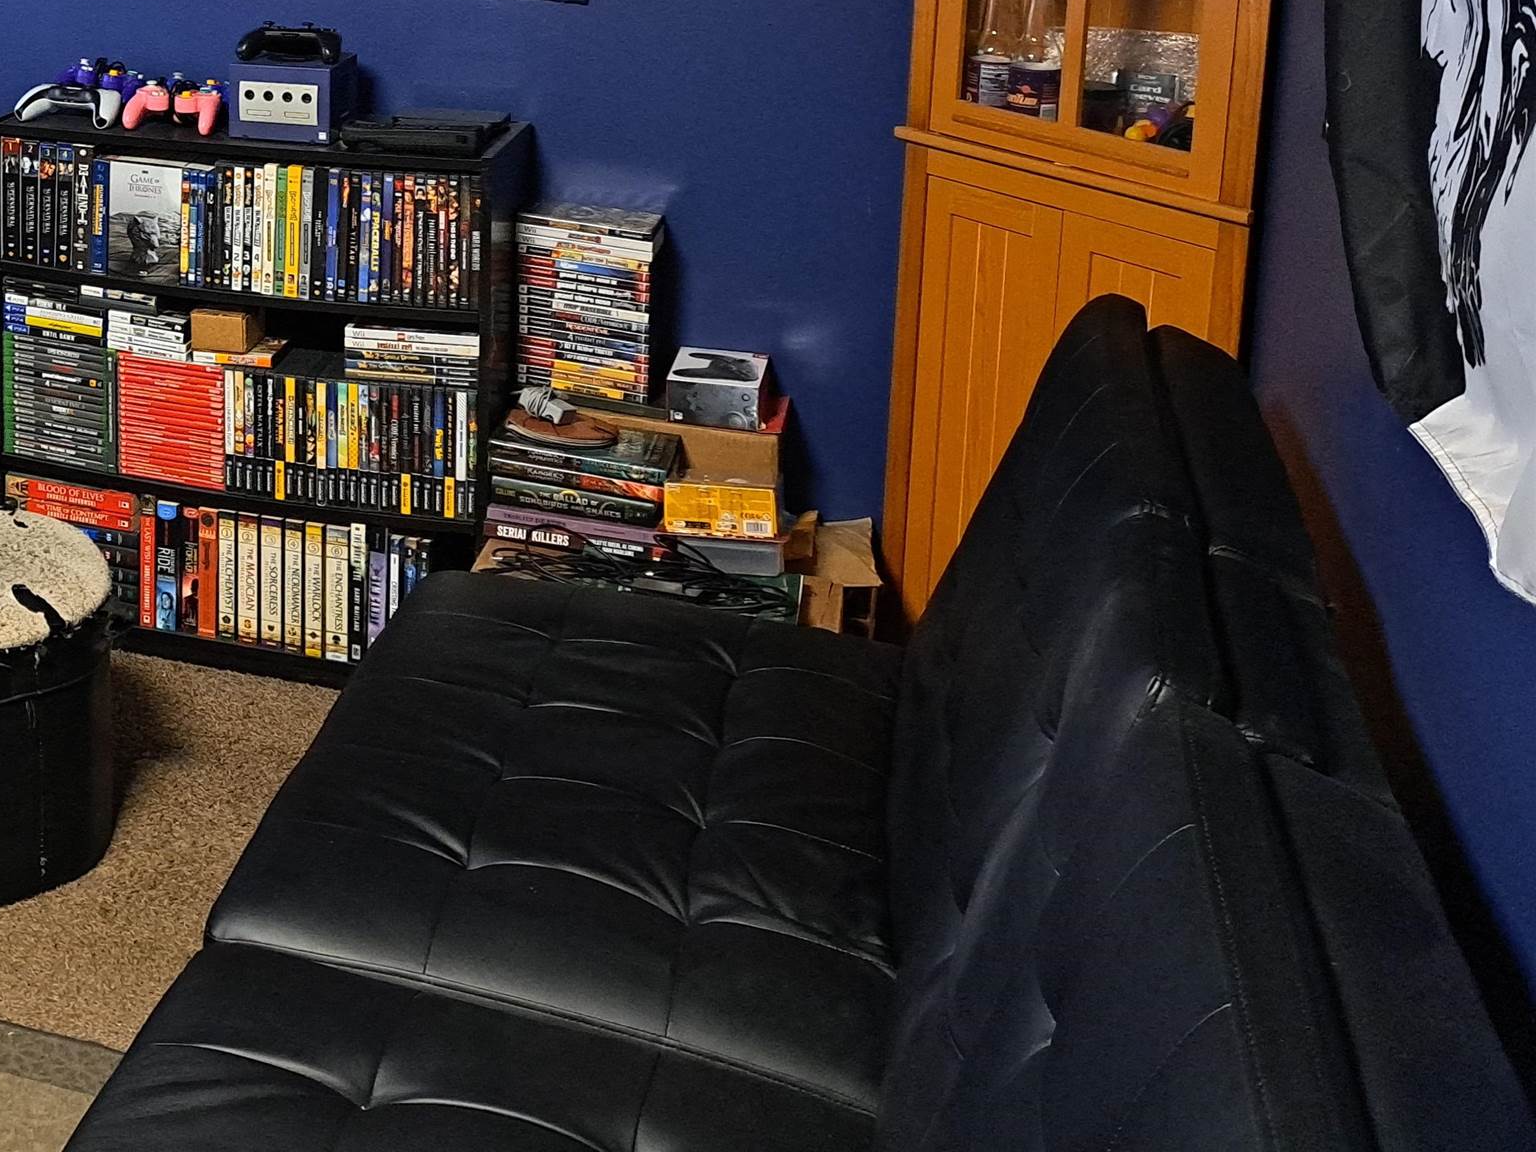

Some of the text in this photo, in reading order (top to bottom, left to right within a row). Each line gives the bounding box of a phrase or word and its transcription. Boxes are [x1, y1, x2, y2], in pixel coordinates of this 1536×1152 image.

[1130, 84, 1162, 94] Card
[128, 183, 162, 194] THRONES
[130, 174, 154, 185] GAME
[371, 211, 380, 272] SPACEBALLS
[234, 252, 240, 261] 2
[244, 251, 250, 261] 3
[38, 483, 105, 502] BLOOD OF ELVES
[540, 491, 552, 499] THE
[553, 493, 589, 506] BALLAD
[46, 504, 62, 512] TIME
[71, 508, 109, 521] CONTEMPT
[520, 496, 569, 510] SONGBIRDS
[586, 507, 622, 519] SNAKES
[531, 531, 570, 547] KILLERS
[158, 548, 171, 572] RIDE
[225, 556, 234, 611] ALCHEMYST
[246, 562, 255, 611] MAGICIAN
[270, 566, 278, 616] SORCERESS
[291, 568, 300, 624] NECROMANCER
[313, 577, 321, 623] WARLOCK
[335, 573, 343, 631] ENCHANTRESS
